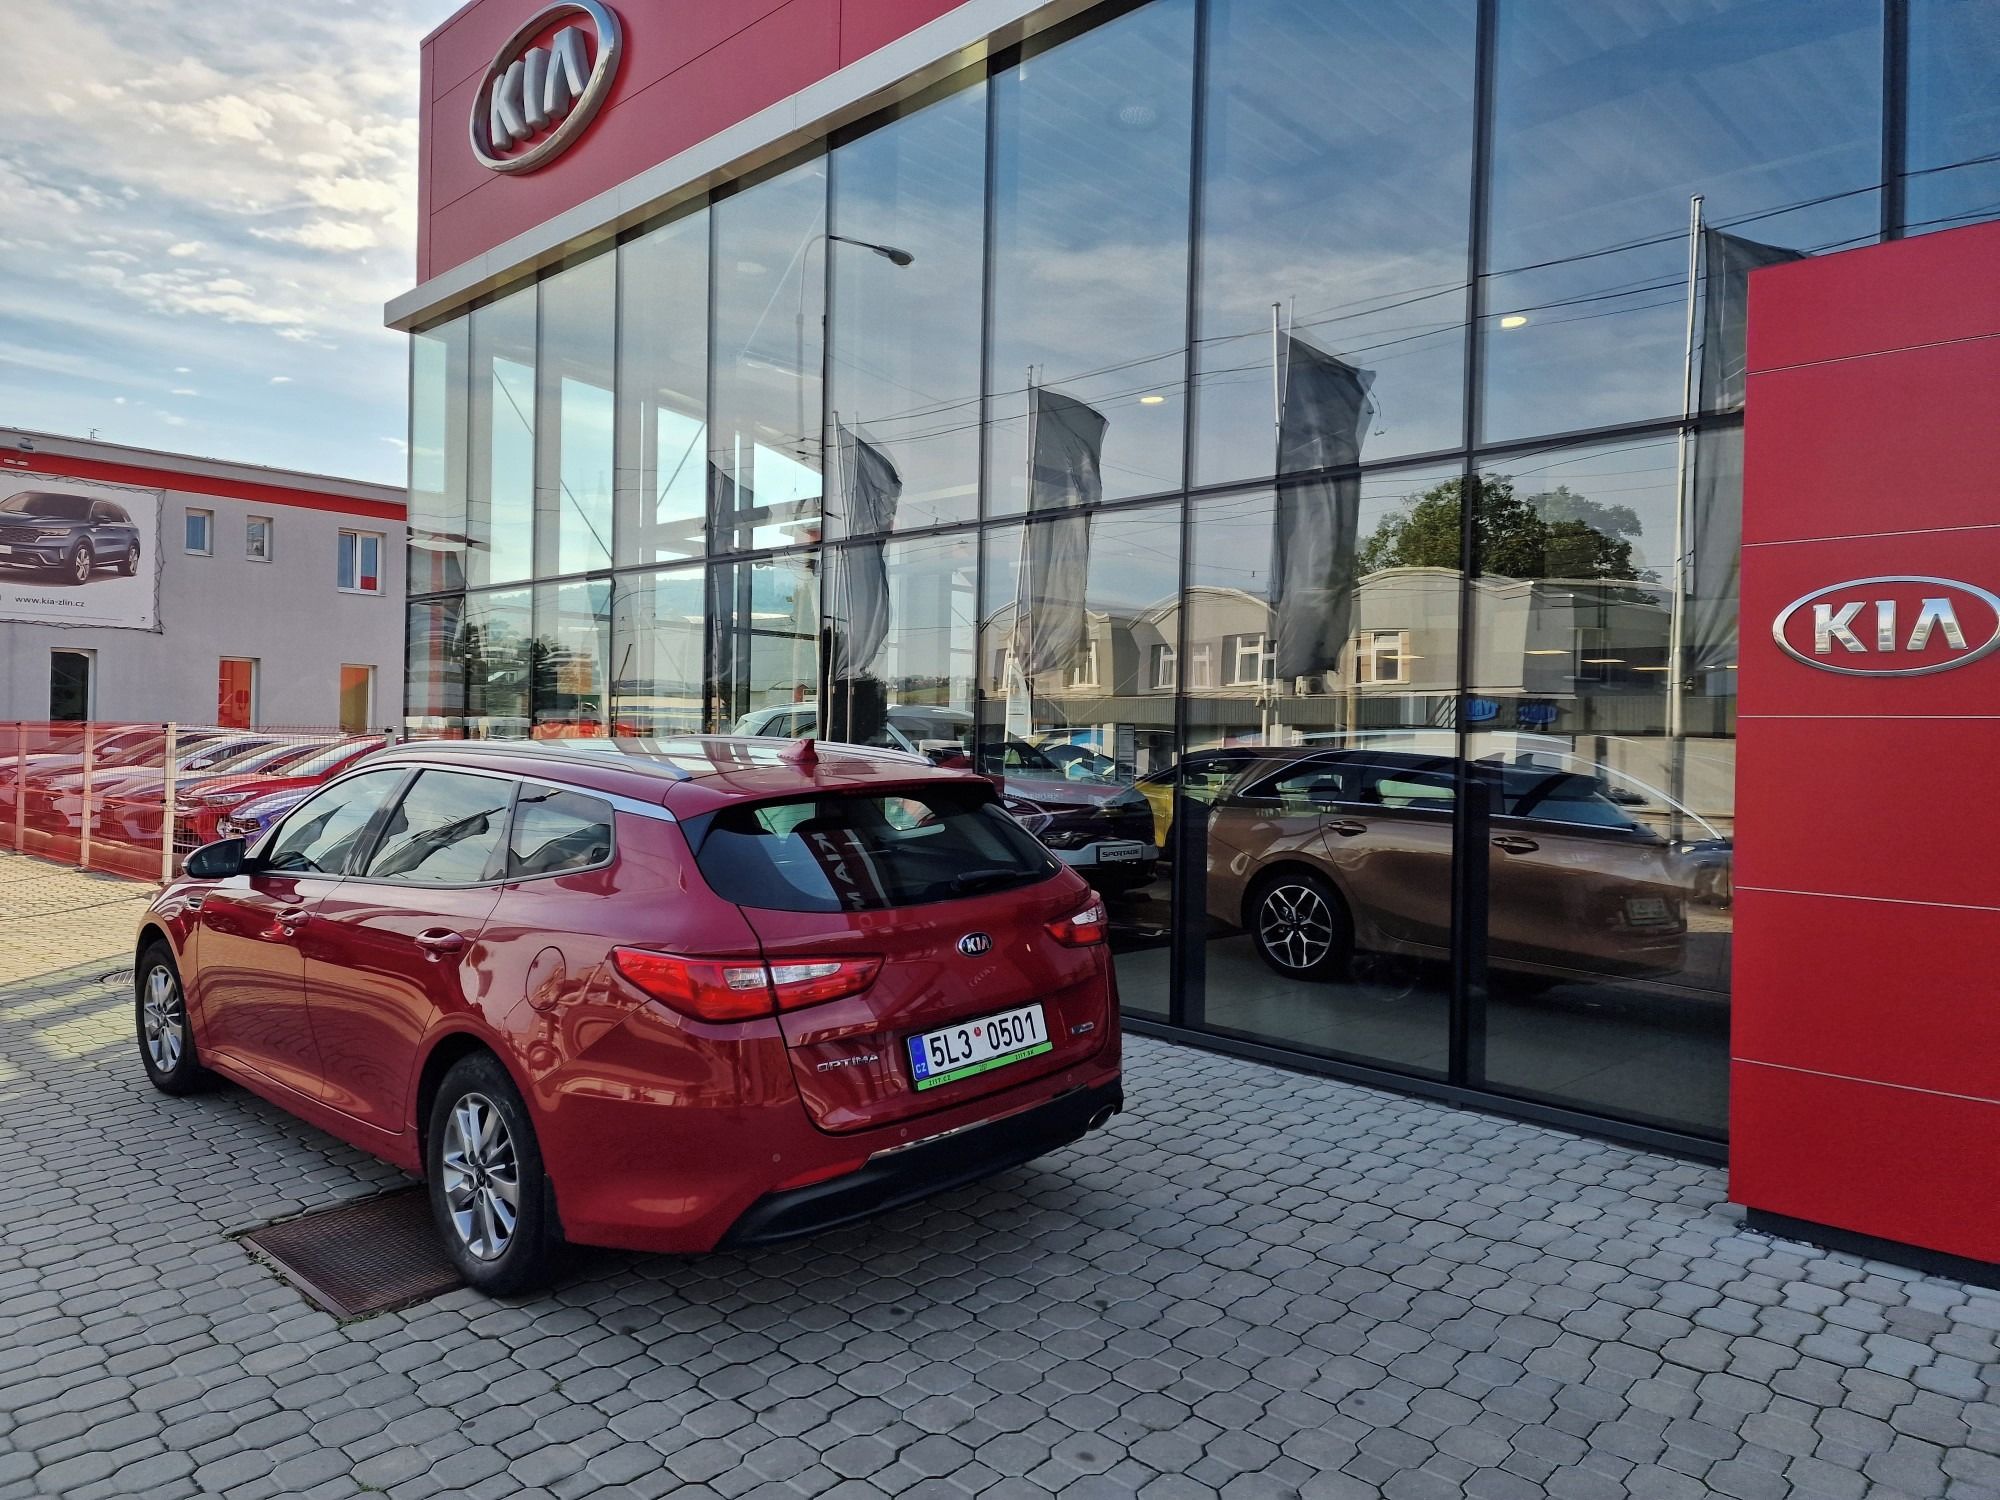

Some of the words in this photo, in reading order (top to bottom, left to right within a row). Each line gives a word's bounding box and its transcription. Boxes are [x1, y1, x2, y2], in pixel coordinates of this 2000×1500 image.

[490, 26, 591, 149] KIA
[15, 595, 85, 608] www.kia-zlin.cz
[1813, 597, 1969, 655] KIA
[965, 935, 990, 953] KIA
[930, 1029, 973, 1067] 5L3
[986, 1011, 1037, 1050] 0501
[816, 1054, 879, 1073] OPTIMA
[915, 1062, 927, 1073] CZ
